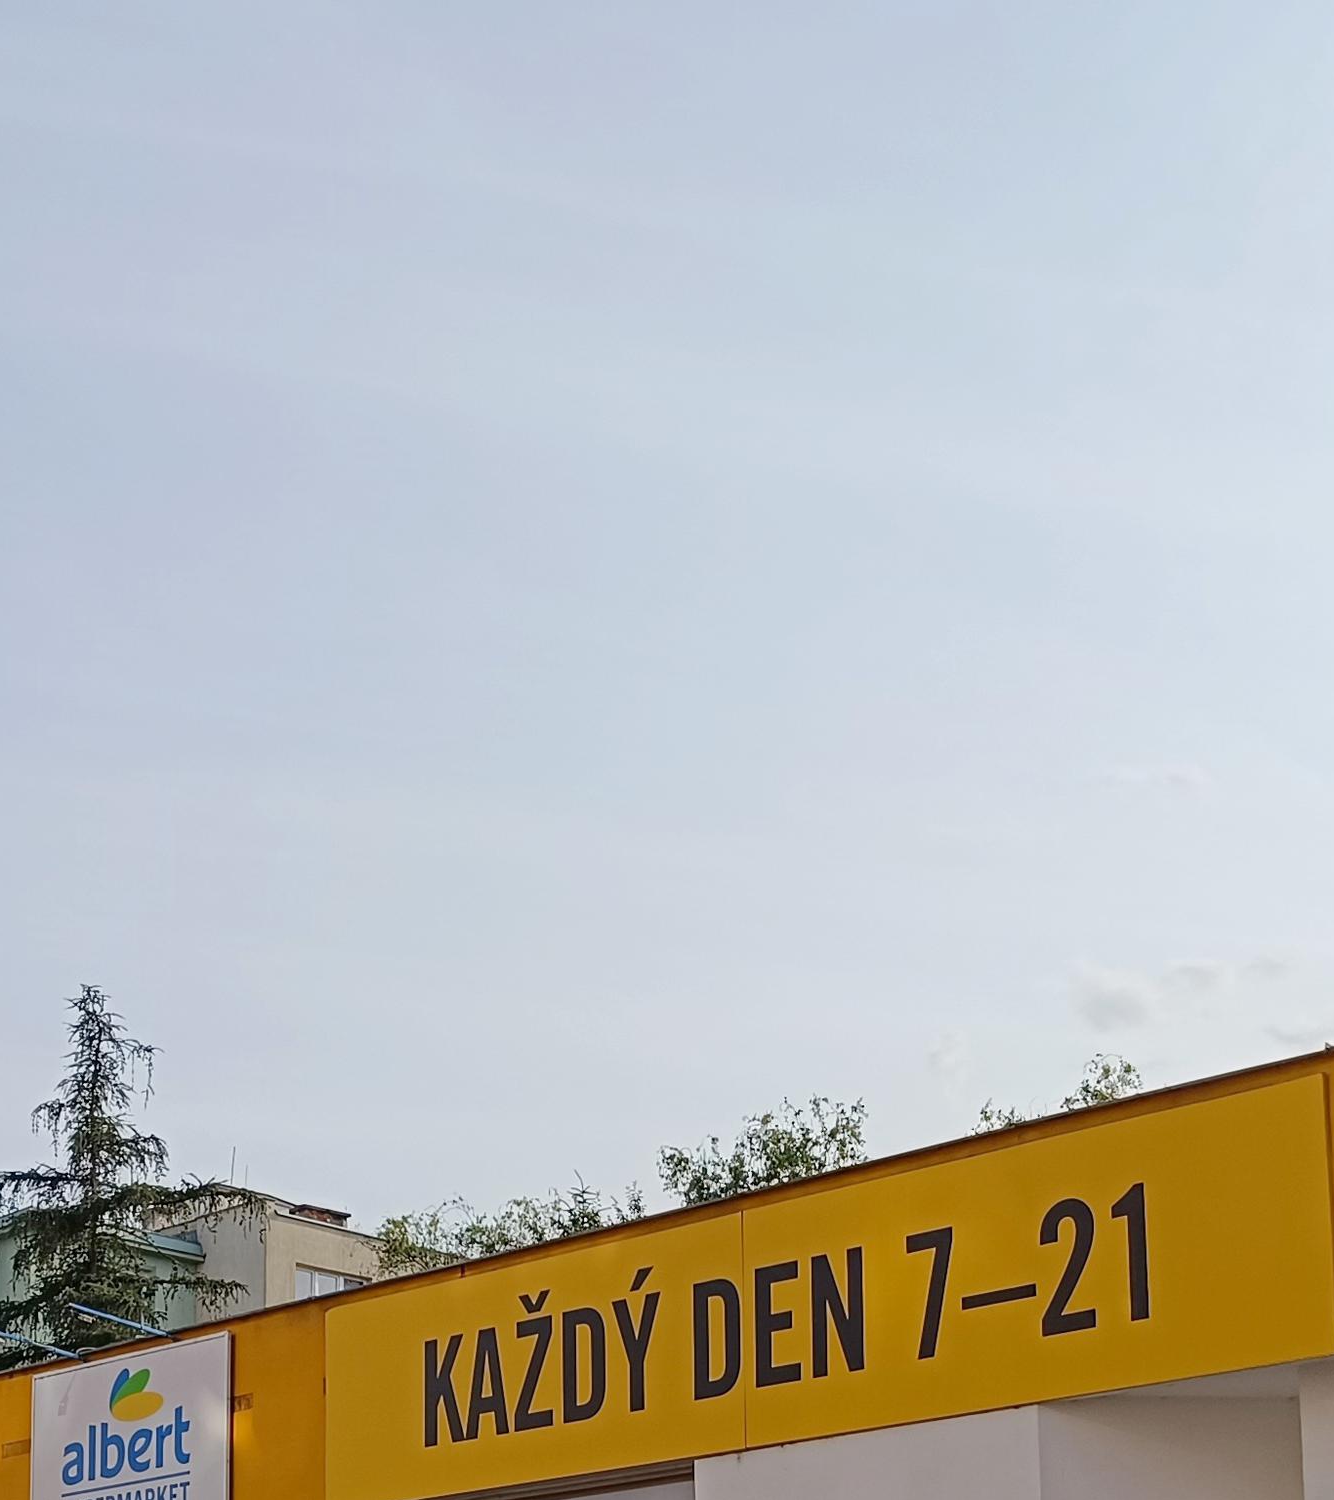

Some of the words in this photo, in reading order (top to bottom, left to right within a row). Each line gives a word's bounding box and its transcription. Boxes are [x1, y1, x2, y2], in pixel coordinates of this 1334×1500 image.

[423, 1267, 660, 1447] KAŽDÝ
[693, 1246, 864, 1401] DEN
[62, 1405, 190, 1485] albert
